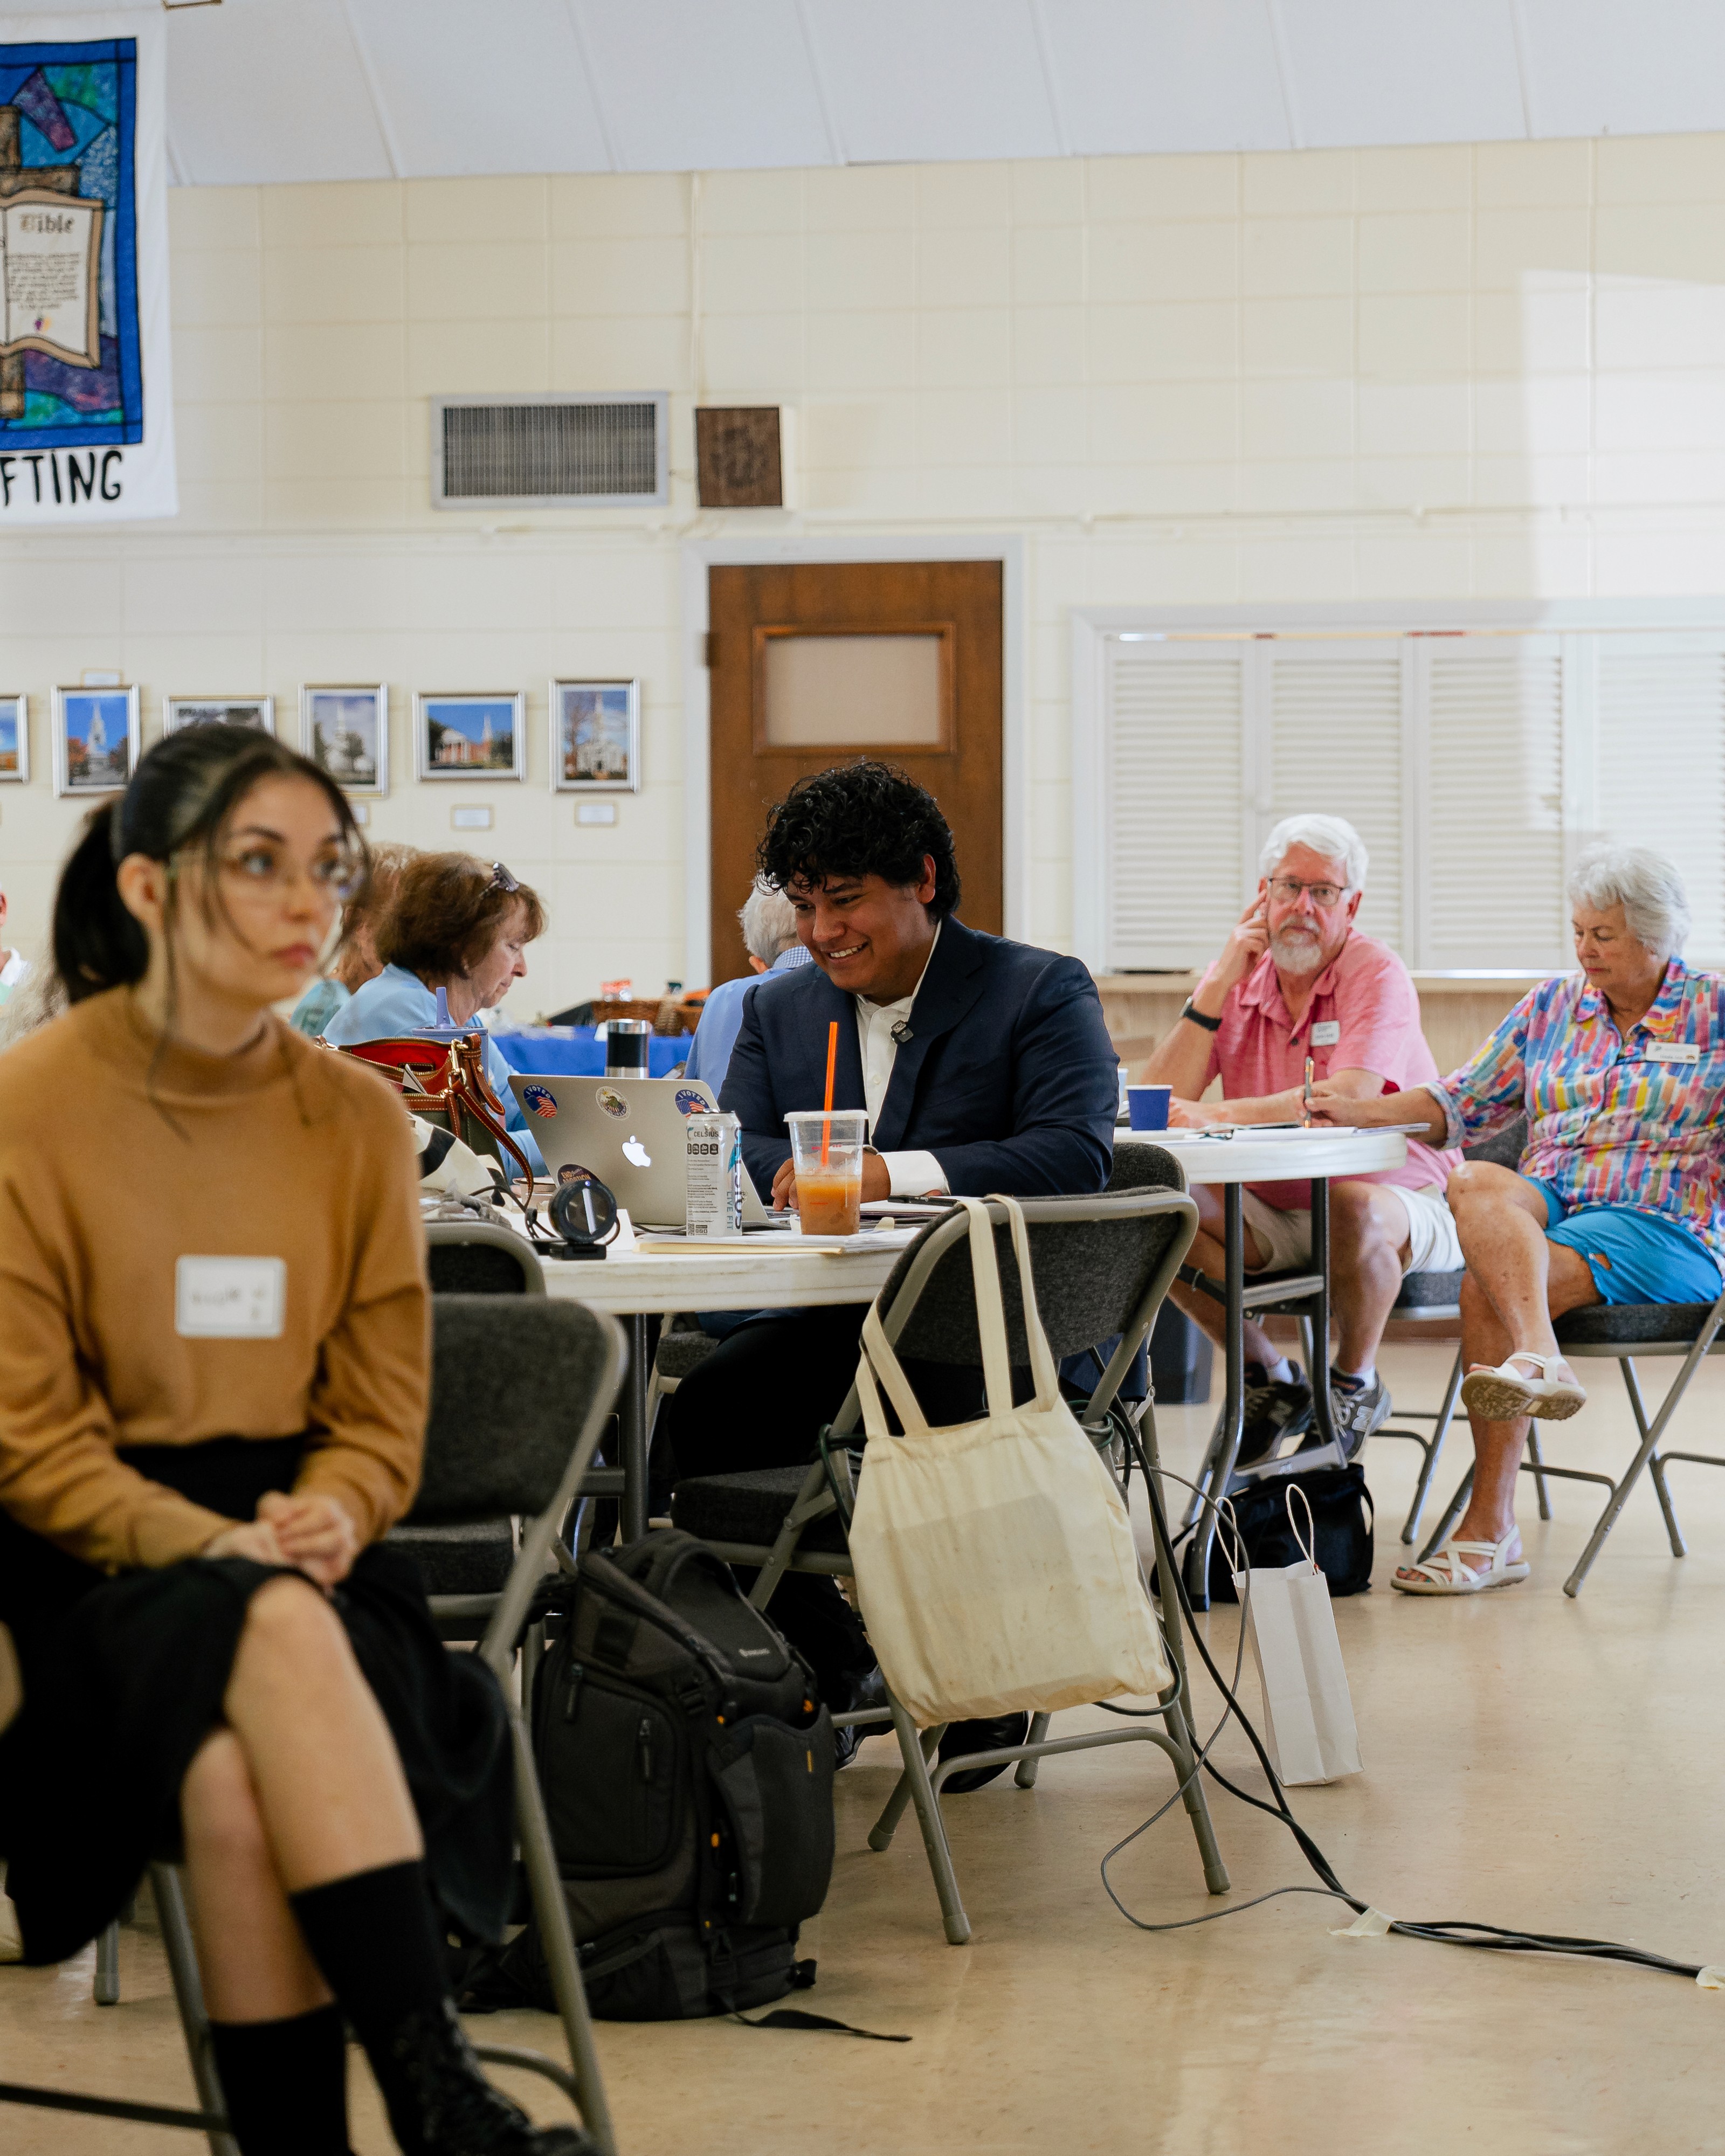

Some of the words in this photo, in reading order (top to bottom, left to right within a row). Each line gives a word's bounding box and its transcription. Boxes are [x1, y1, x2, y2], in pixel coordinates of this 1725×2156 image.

[0, 450, 122, 506] FTING
[528, 1086, 550, 1098] VOTED
[681, 1090, 706, 1105] VOTED
[561, 1171, 572, 1179] END
